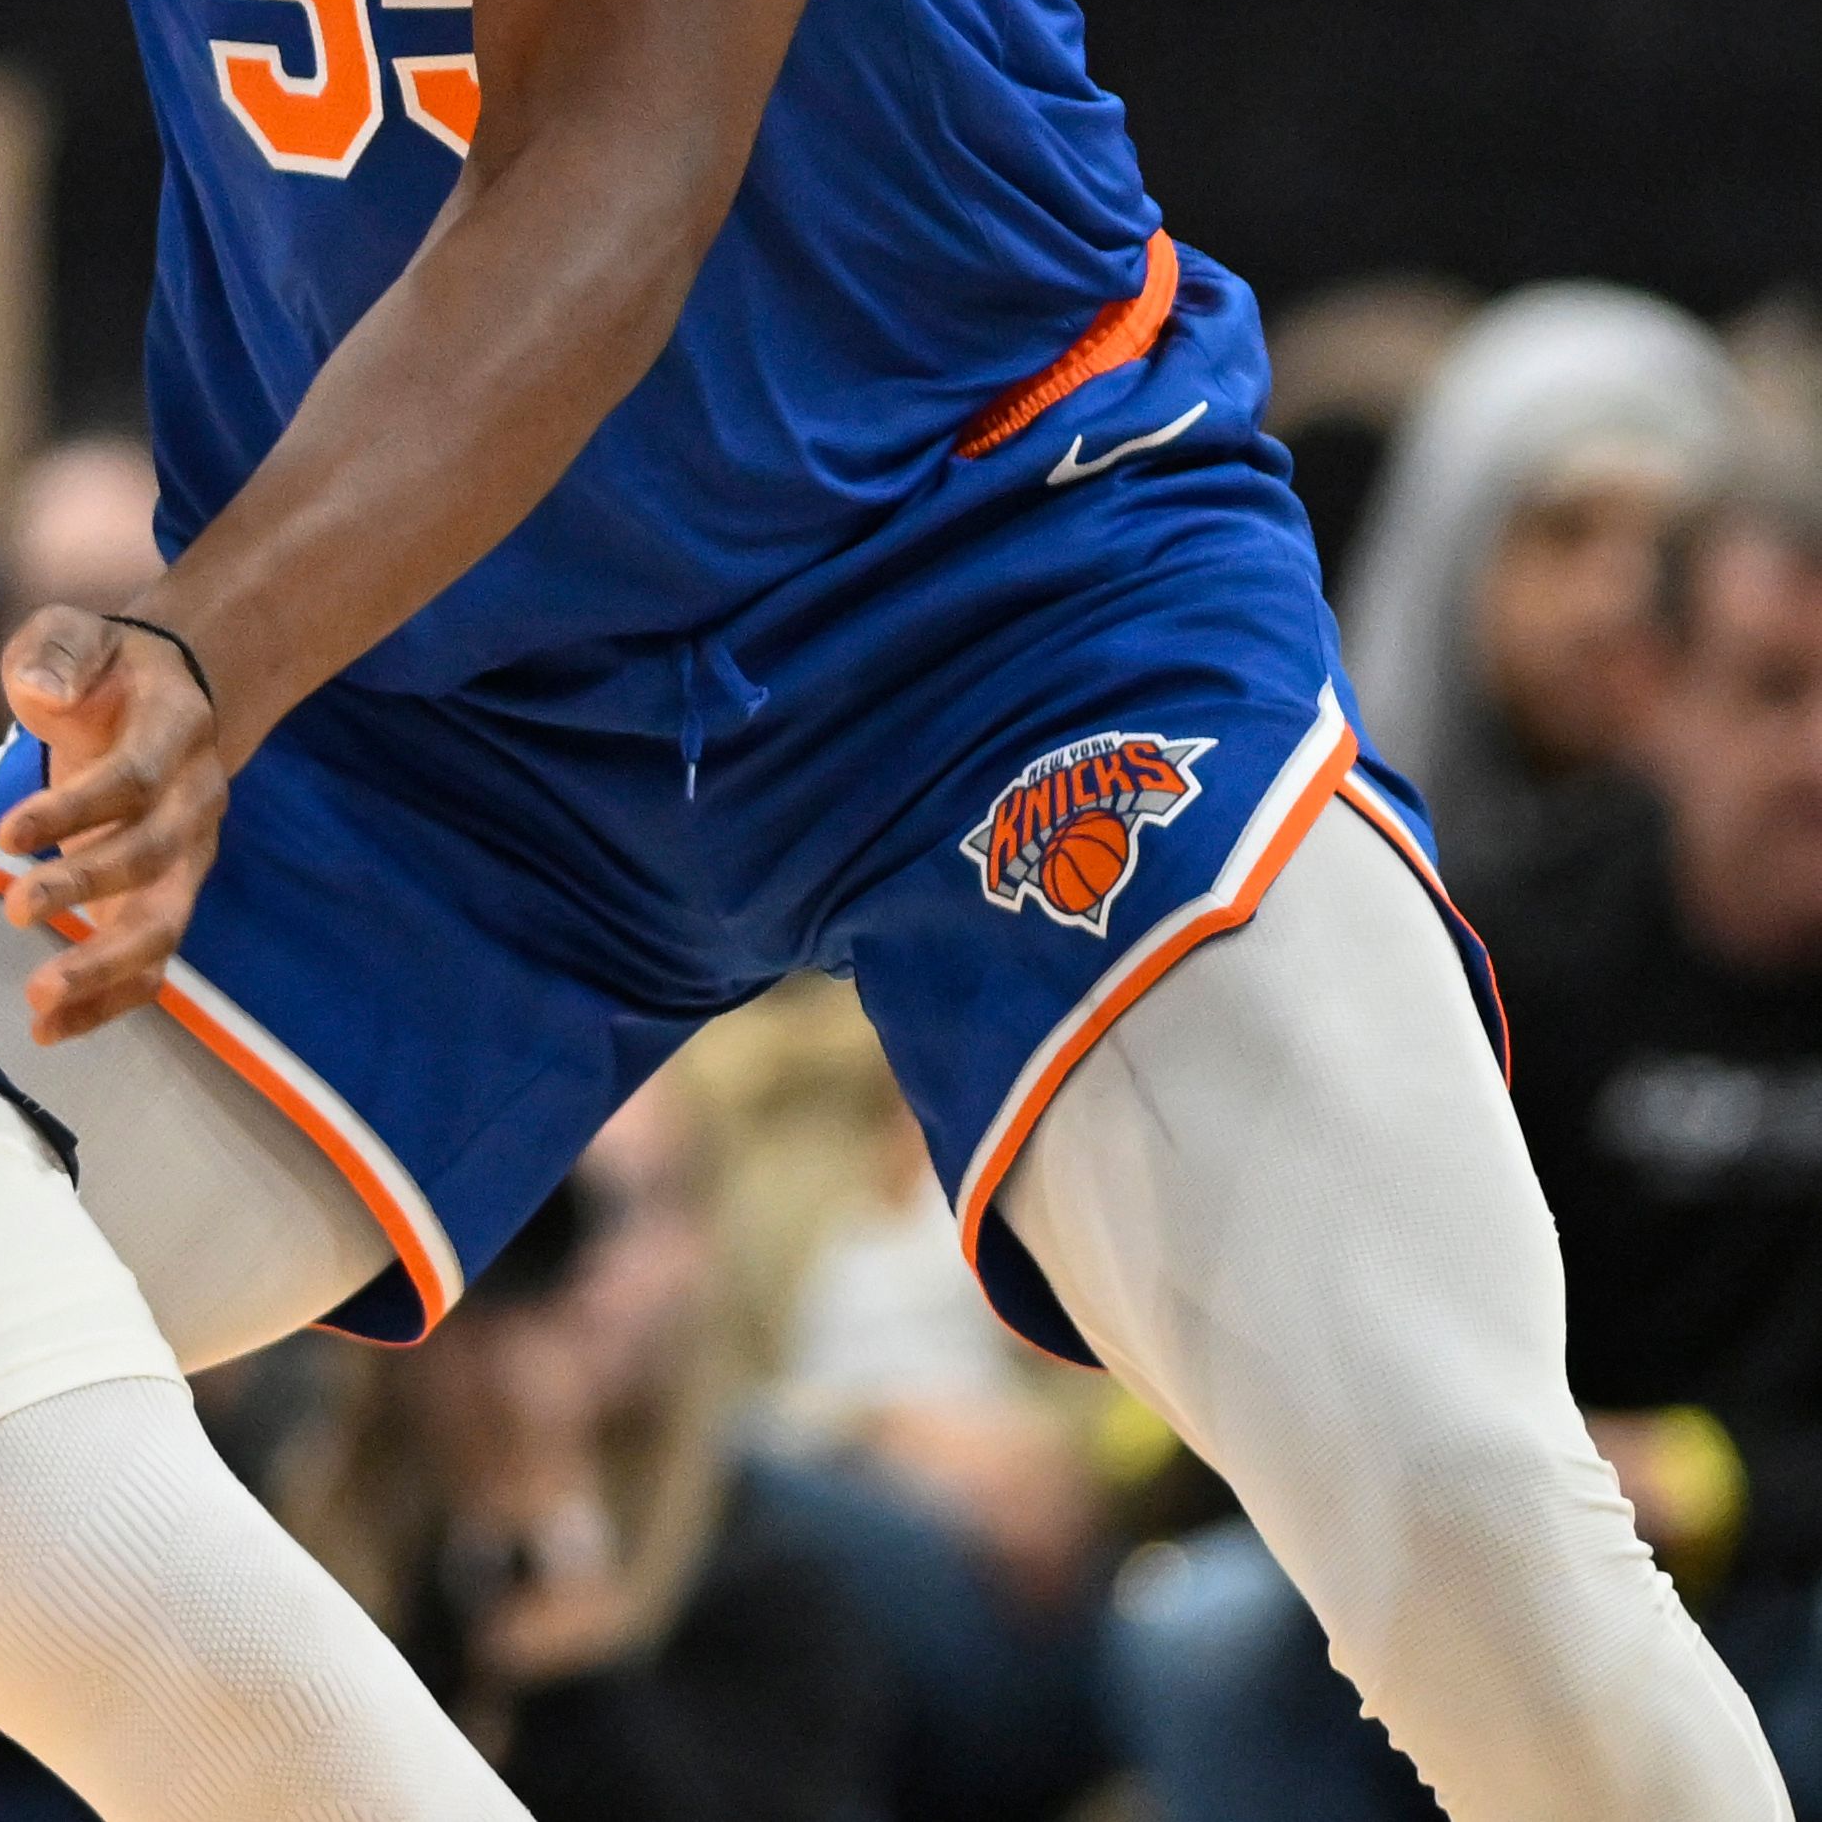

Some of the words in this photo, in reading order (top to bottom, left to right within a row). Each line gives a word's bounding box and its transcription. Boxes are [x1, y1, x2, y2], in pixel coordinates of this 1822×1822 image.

[1027, 750, 1065, 786] NEW
[1068, 737, 1116, 761] YORK
[986, 740, 1190, 892] KNICKS
